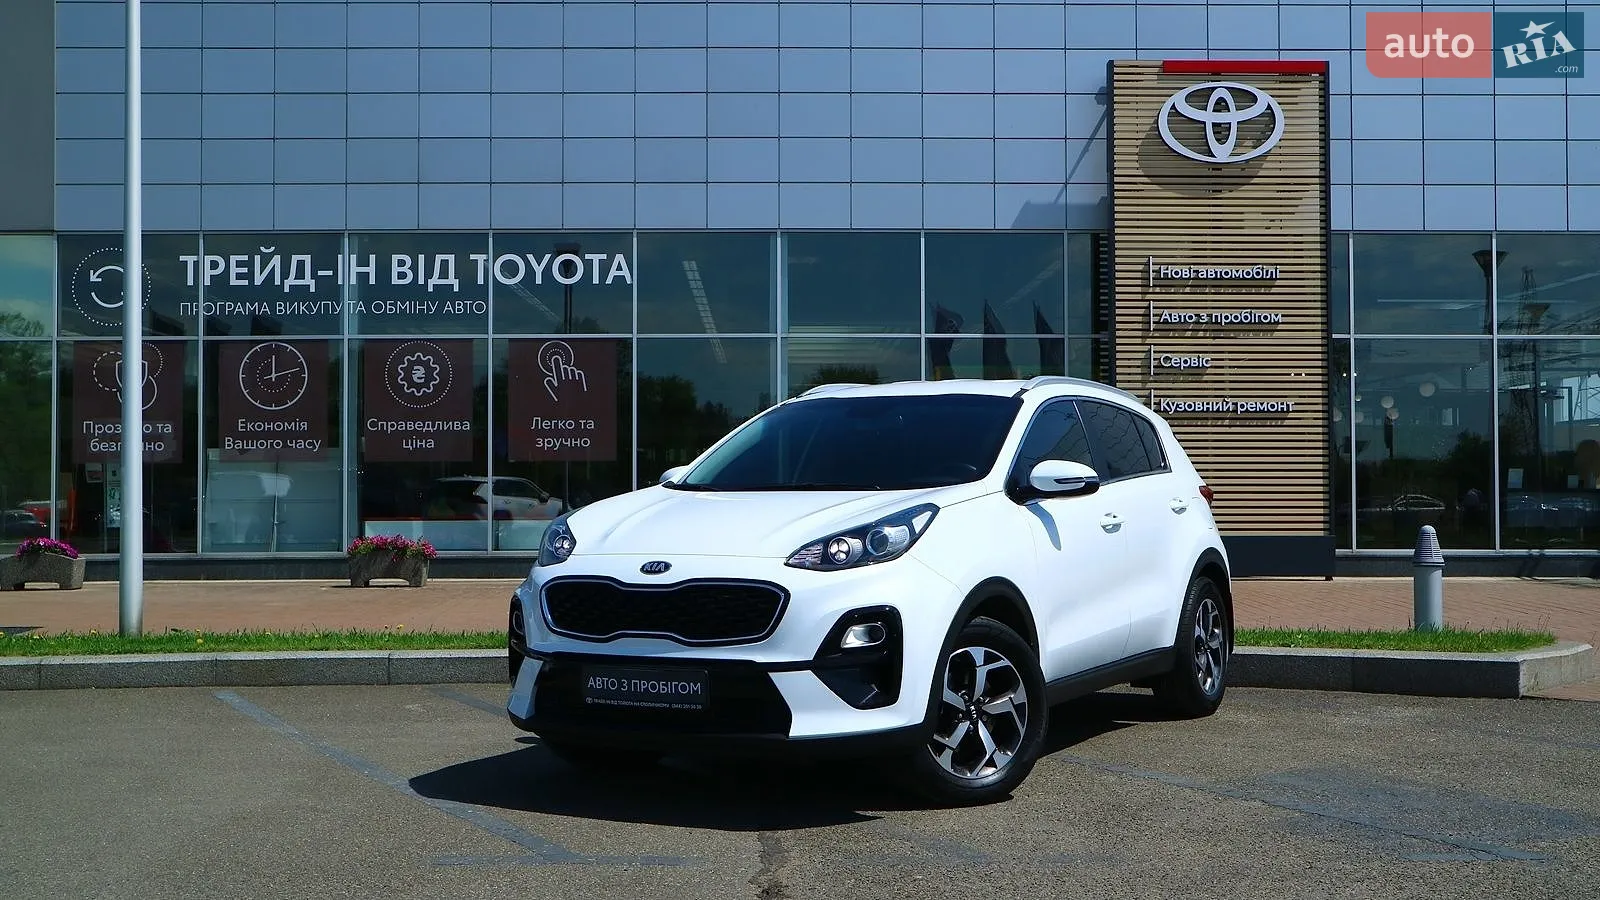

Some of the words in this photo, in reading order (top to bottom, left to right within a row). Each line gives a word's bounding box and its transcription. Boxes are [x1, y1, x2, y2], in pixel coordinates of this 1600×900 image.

[179, 246, 376, 292] ТРЕЙД-ІН
[391, 254, 459, 292] ВІД
[469, 253, 633, 285] TOYOTA
[1160, 265, 1194, 279] Нові
[1198, 265, 1280, 279] автомобілі
[179, 302, 270, 316] ПРОГРАМА
[276, 302, 343, 315] ВИКУПУ
[347, 300, 367, 314] ТА
[371, 300, 439, 315] ОБМІНУ
[443, 300, 487, 314] АВТО
[1160, 309, 1196, 323] Авто
[1199, 313, 1209, 323] з
[1212, 309, 1282, 326] пробігом
[1160, 354, 1212, 370] Сервіс
[1160, 397, 1233, 415] Кузовний
[1237, 401, 1295, 415] ремонт
[83, 421, 152, 436] Прозо
[156, 423, 172, 433] та
[238, 418, 308, 431] Економія
[367, 418, 471, 434] Справедлива
[530, 416, 575, 430] Легко
[579, 419, 595, 430] та
[90, 438, 165, 451] безно
[225, 437, 283, 449] Вашого
[287, 439, 322, 452] часу
[402, 436, 435, 451] ціна
[535, 438, 591, 450] зручно
[643, 562, 666, 572] KIA
[587, 676, 618, 690] АВТО
[631, 680, 701, 695] ПРОБІГОМ
